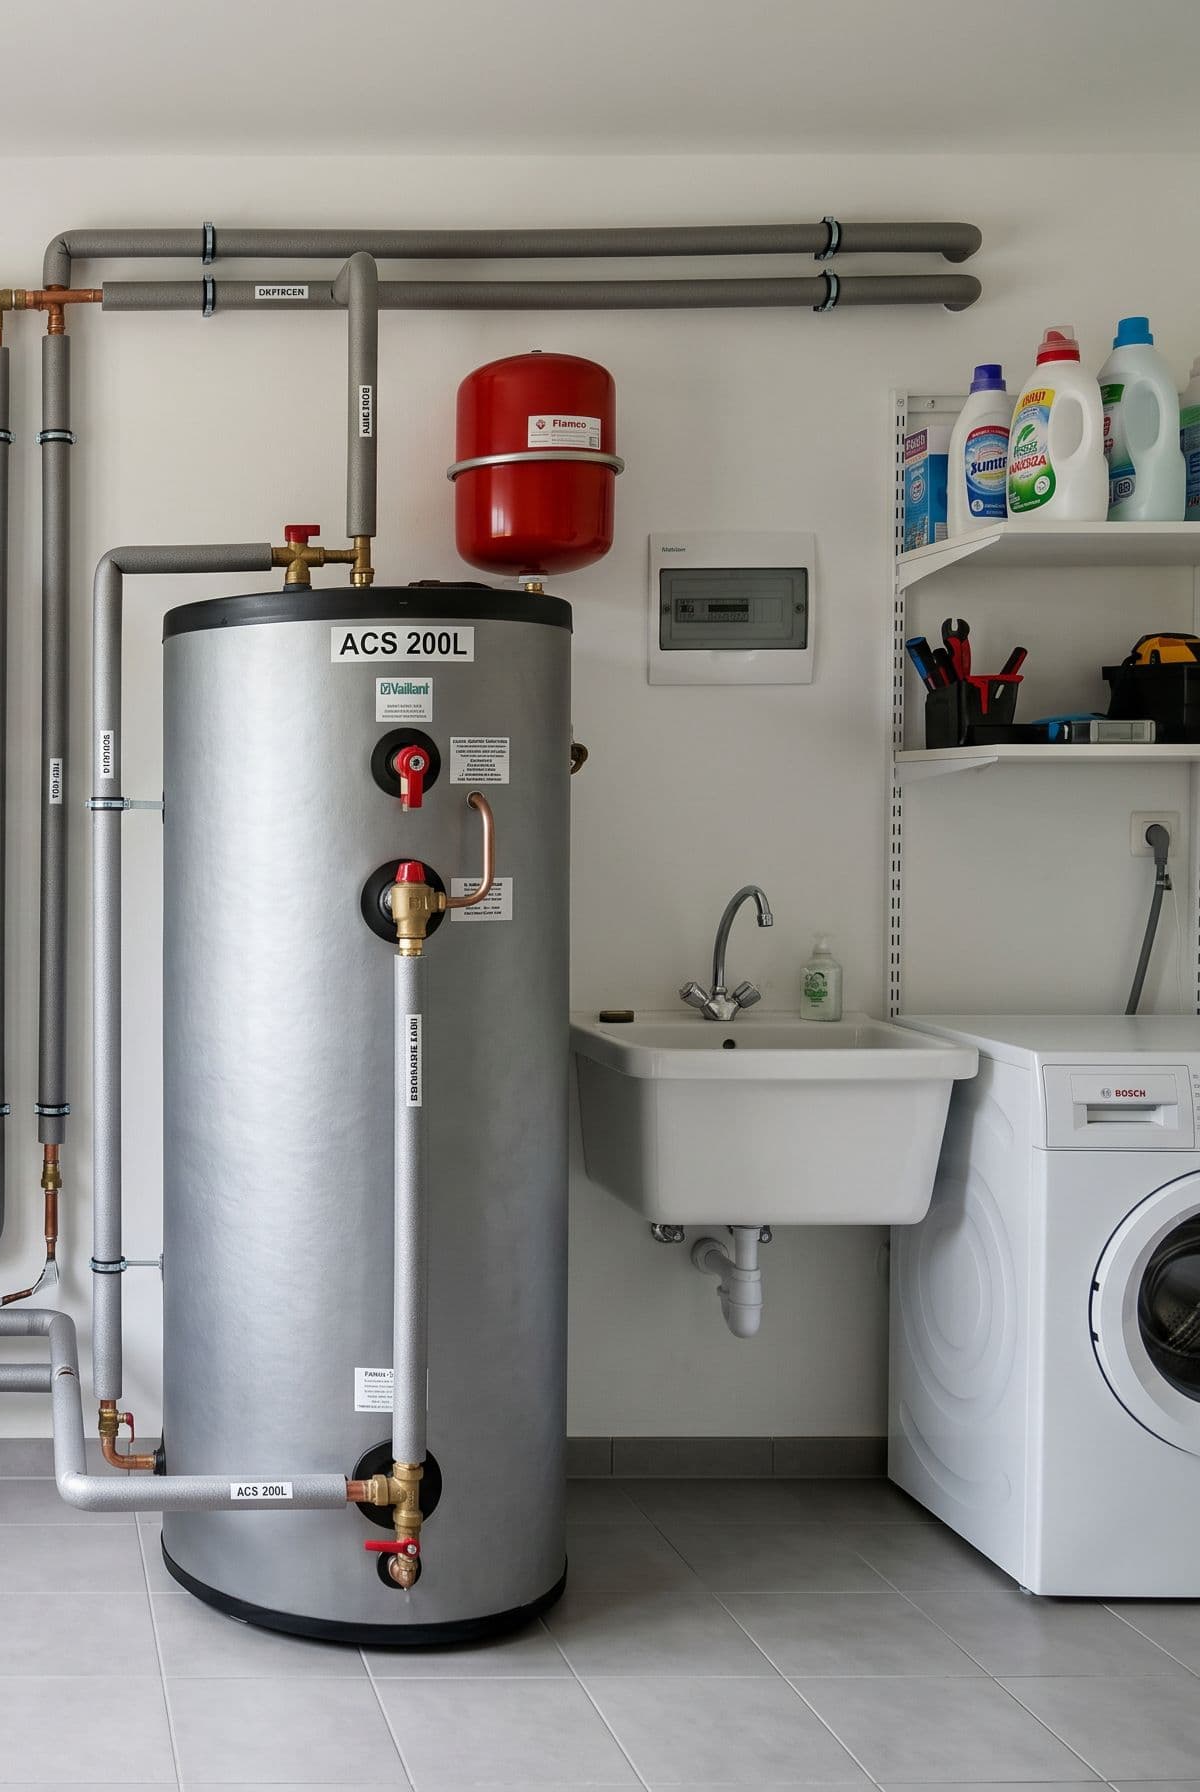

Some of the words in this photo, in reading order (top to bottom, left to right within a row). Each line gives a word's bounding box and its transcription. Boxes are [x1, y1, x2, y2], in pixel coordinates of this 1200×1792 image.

[552, 419, 587, 429] Flamco
[339, 631, 398, 656] ACS
[406, 631, 468, 655] 200L
[390, 682, 430, 696] Vaillant
[1115, 1089, 1146, 1098] BOSCH
[237, 1486, 259, 1497] ACS
[262, 1485, 287, 1496] 200L
